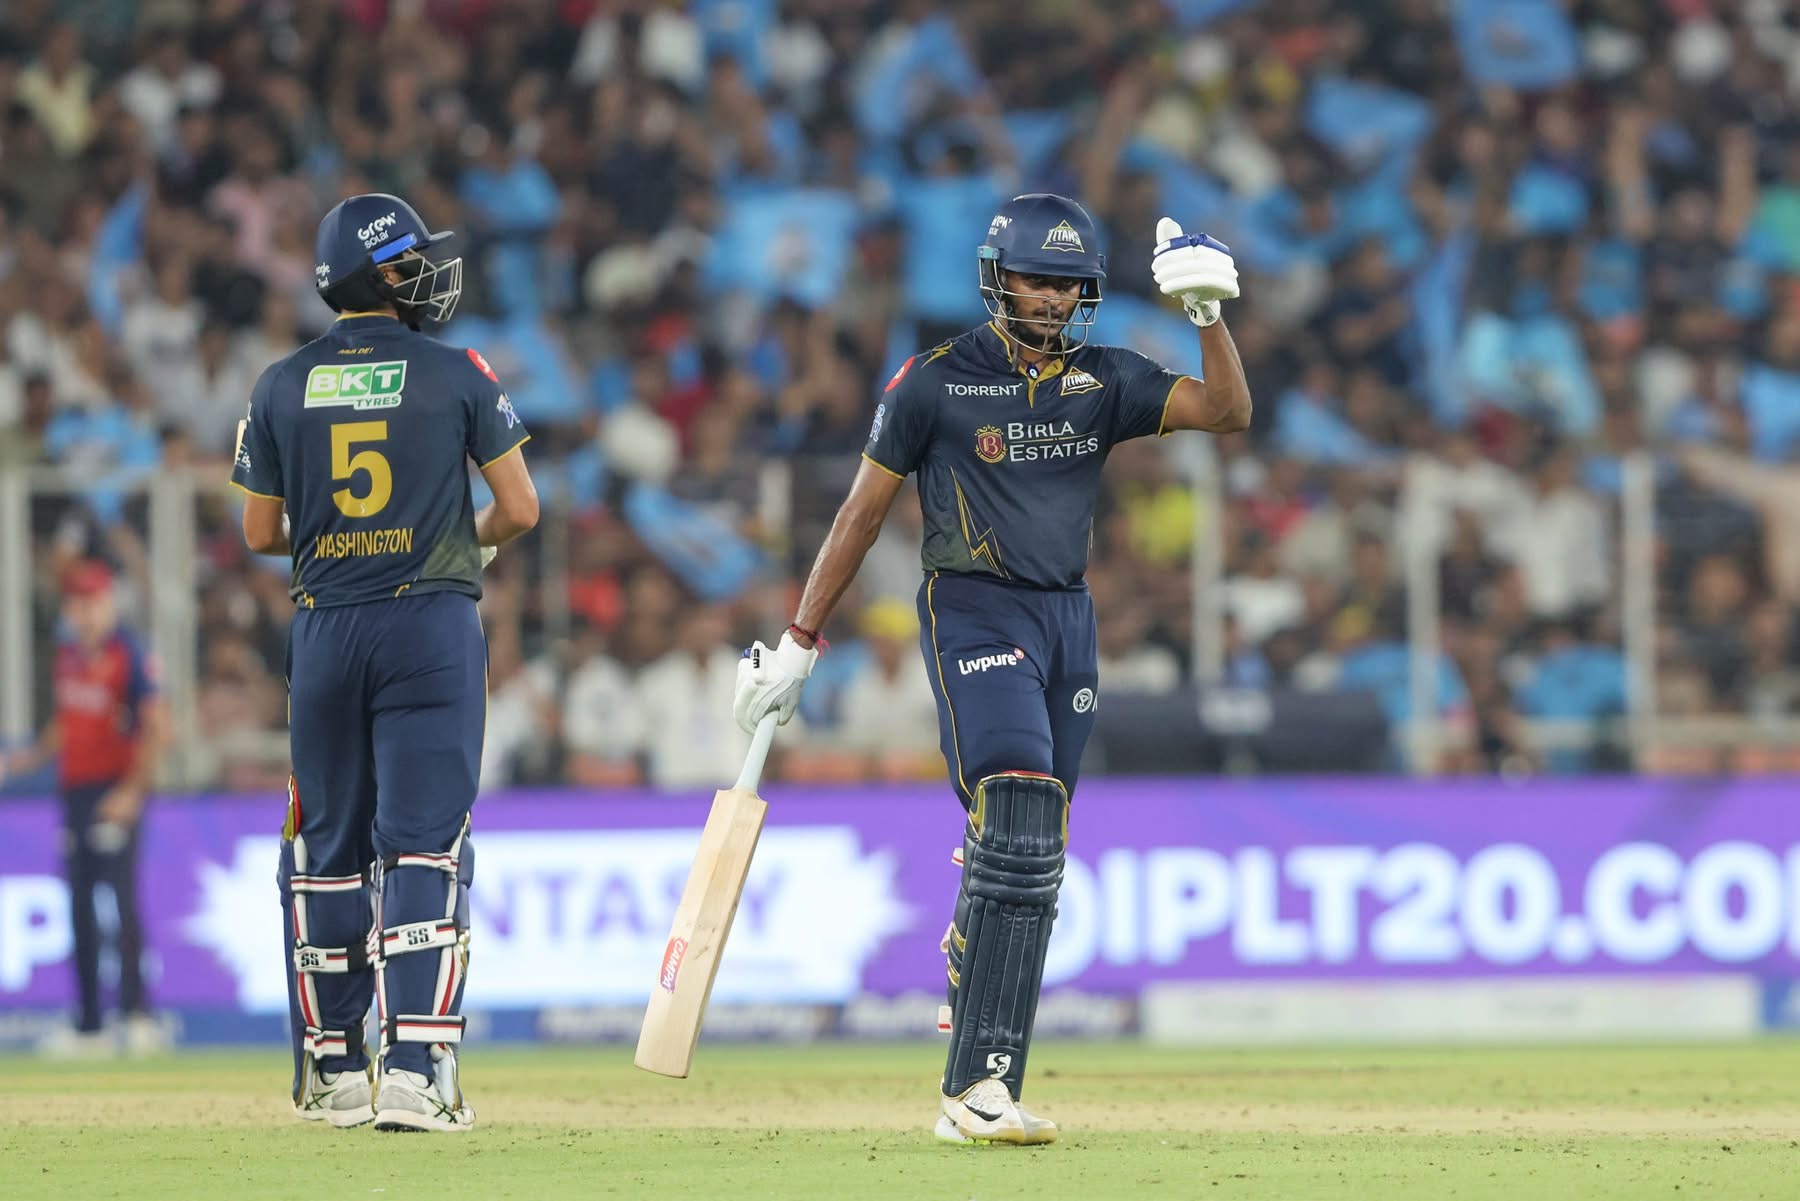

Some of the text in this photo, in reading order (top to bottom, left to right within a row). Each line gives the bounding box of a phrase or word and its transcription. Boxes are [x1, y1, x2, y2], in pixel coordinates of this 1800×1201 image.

[310, 369, 401, 393] BKT
[945, 382, 1022, 396] TORRENT
[356, 396, 399, 408] TYRES
[1007, 420, 1075, 440] BIRLA
[1009, 437, 1099, 462] ESTATES
[331, 420, 392, 517] 5
[314, 527, 413, 559] WASHINGTON
[958, 652, 1017, 675] Livpure
[407, 927, 429, 946] SS
[300, 952, 320, 968] SS
[662, 940, 685, 989] CAMPA
